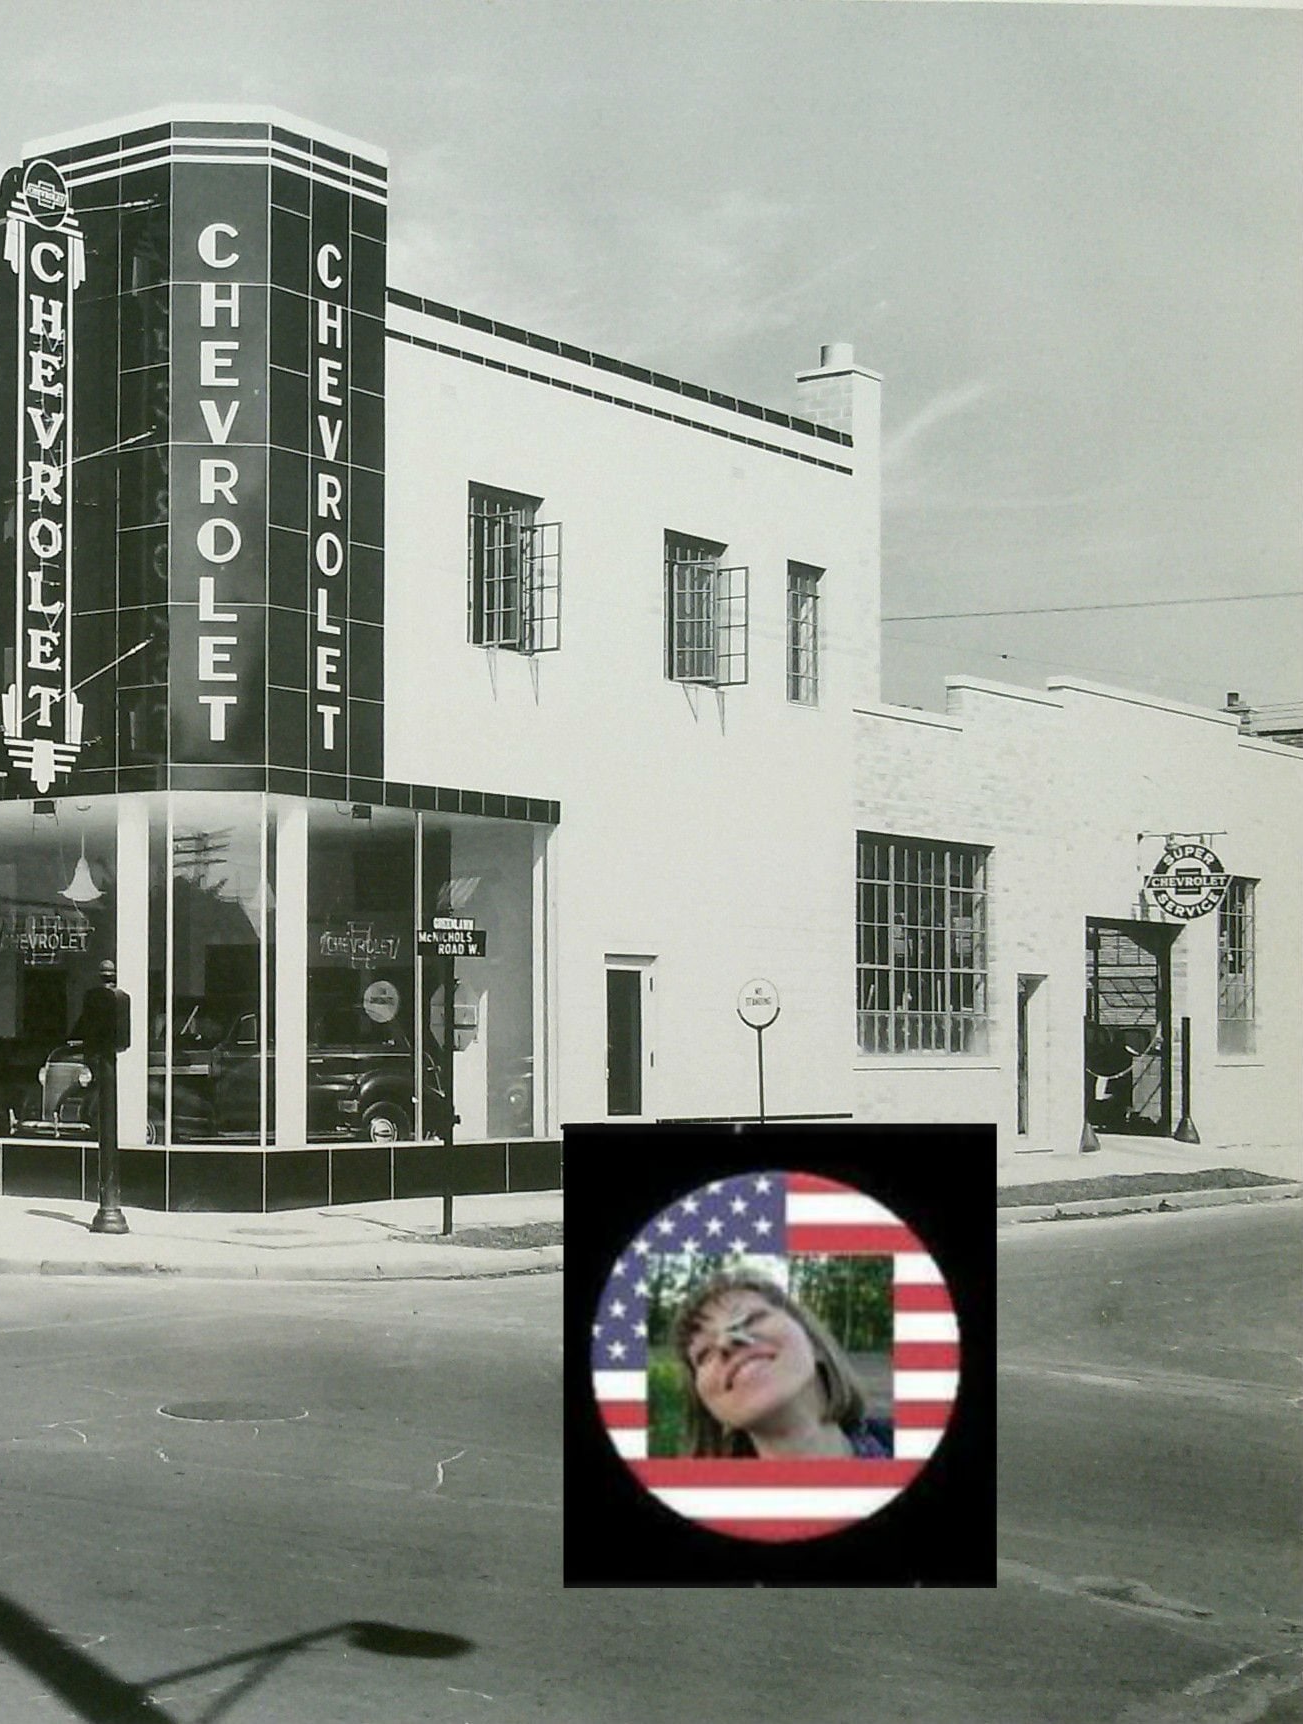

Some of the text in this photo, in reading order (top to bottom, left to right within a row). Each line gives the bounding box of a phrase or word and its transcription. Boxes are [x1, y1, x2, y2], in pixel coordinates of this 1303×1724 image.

[27, 242, 65, 727] CHEVROLET
[197, 223, 242, 741] CHEVROLET
[315, 243, 343, 750] CHEVROLET
[1163, 846, 1215, 865] SUPER
[1151, 877, 1227, 887] CHEVROLET
[1158, 892, 1219, 916] SERVICE
[4, 932, 88, 950] EVROLET
[438, 943, 481, 955] ROAD W.
